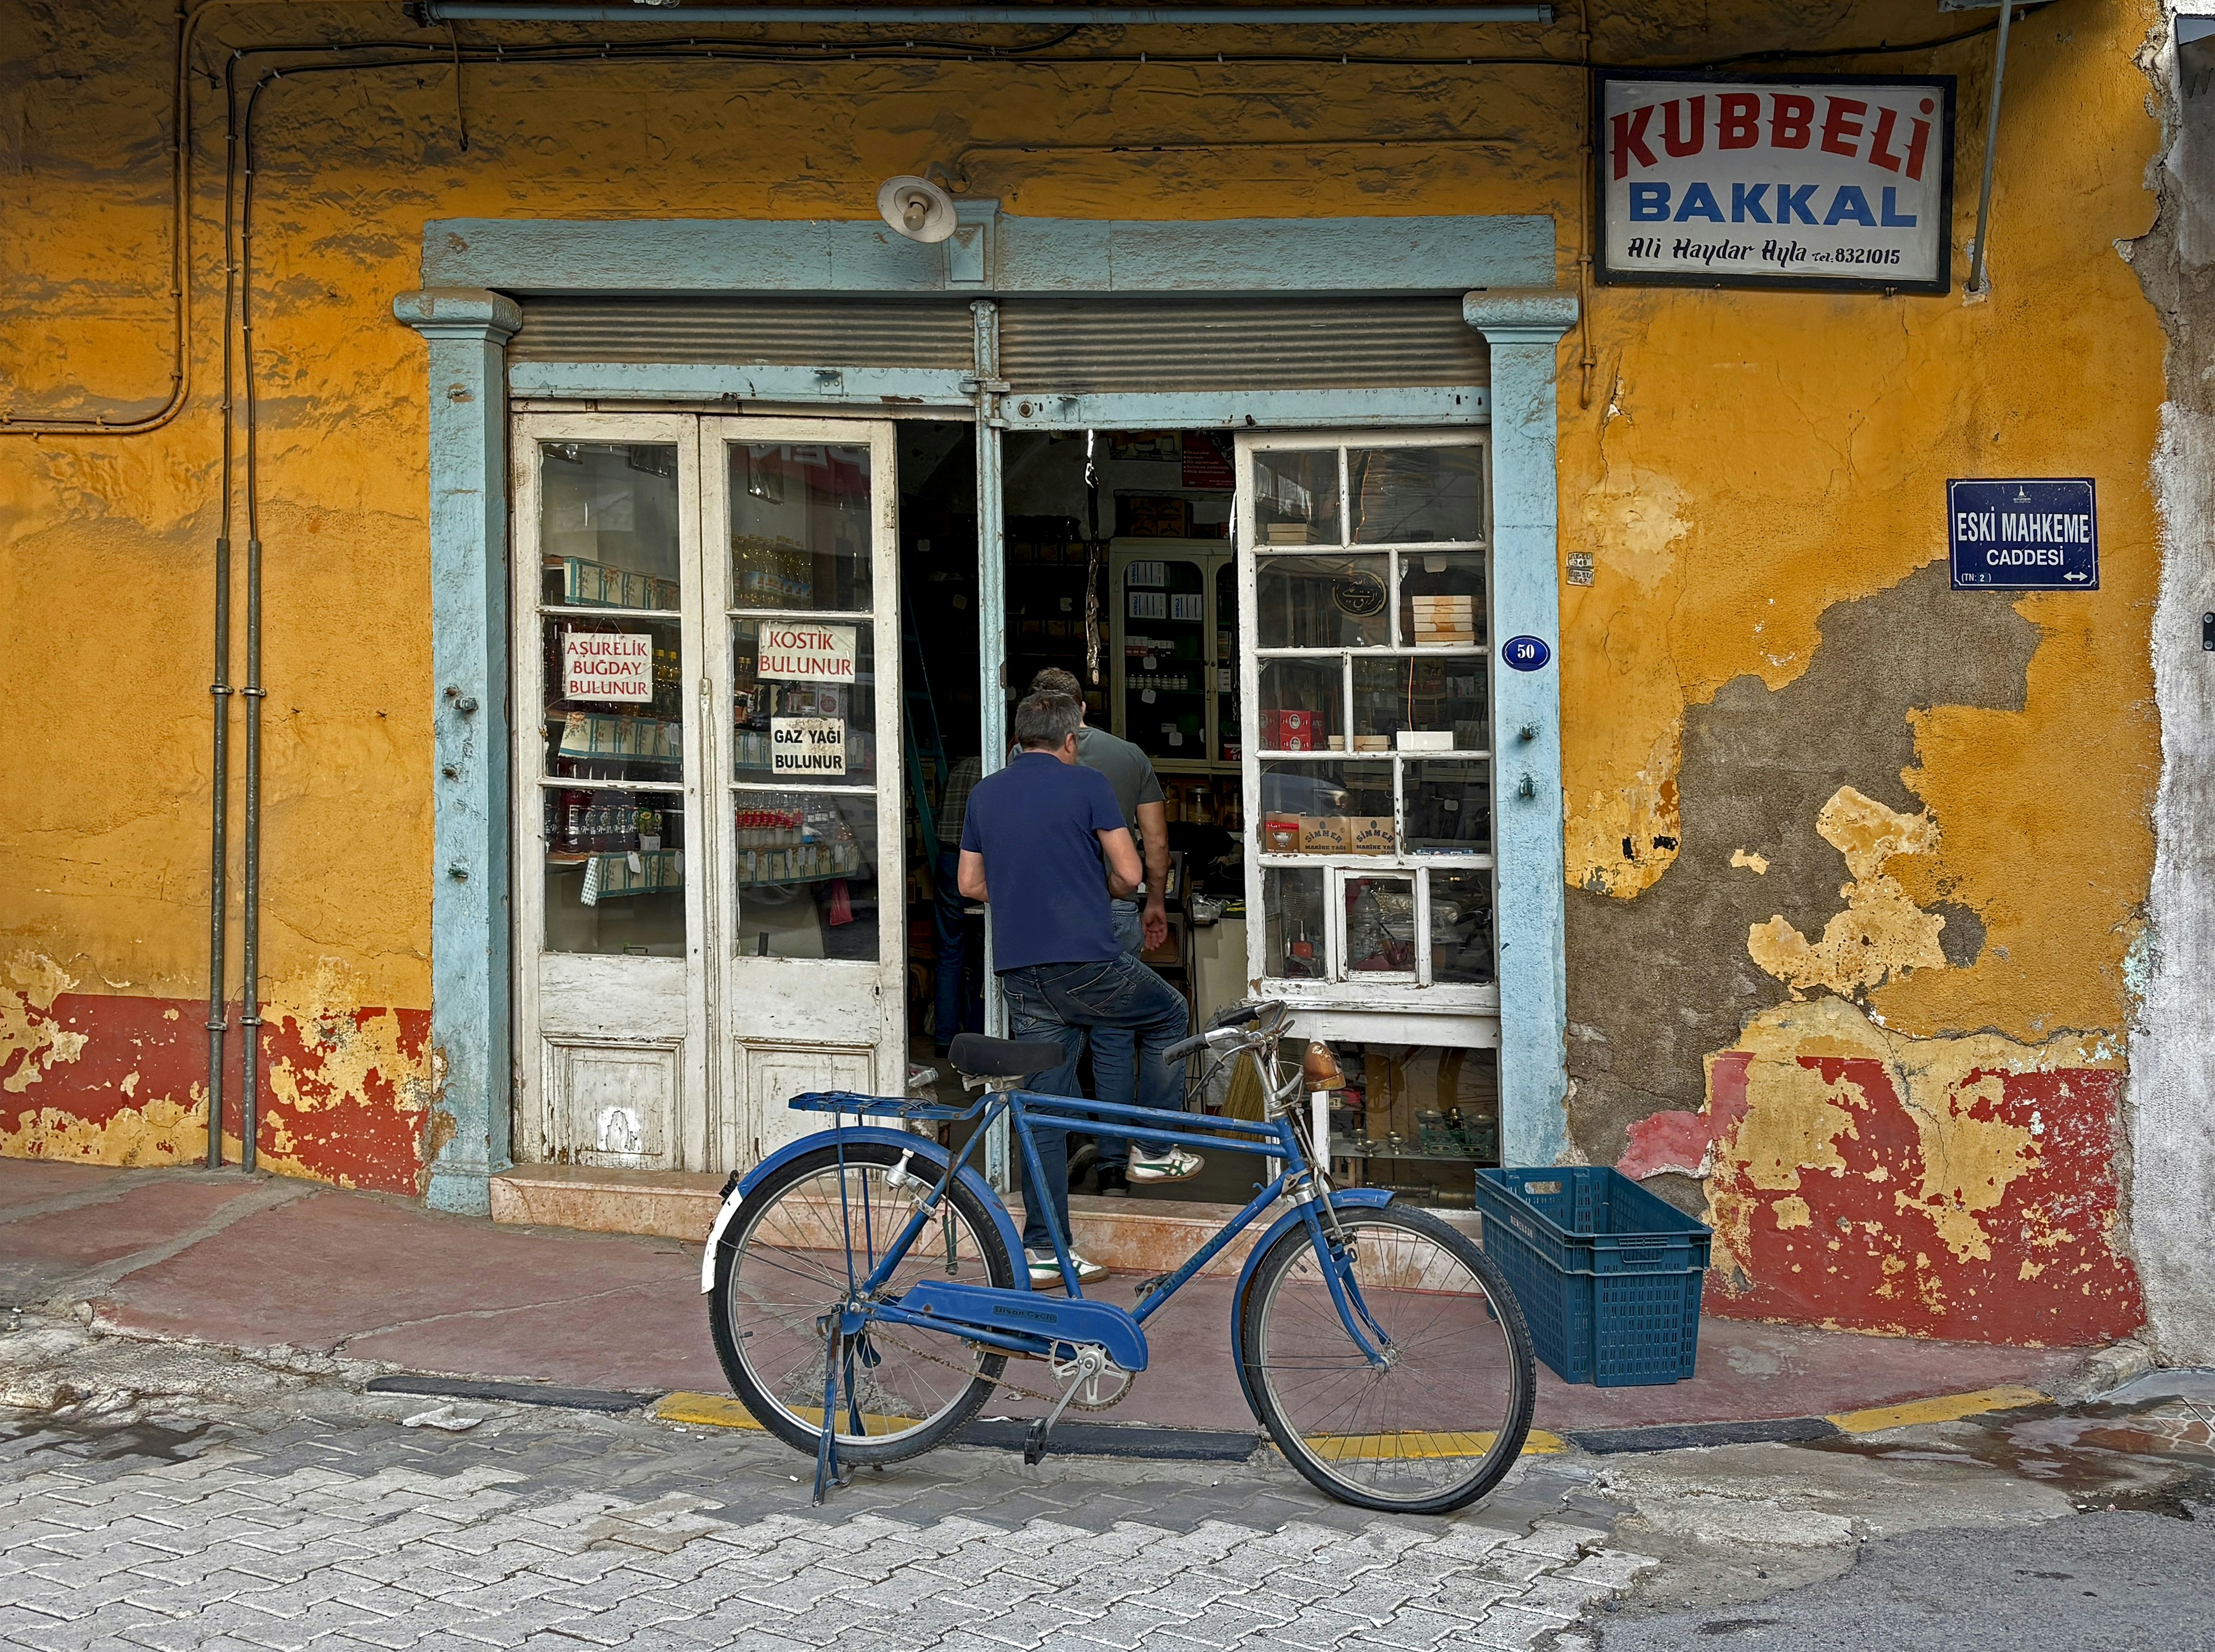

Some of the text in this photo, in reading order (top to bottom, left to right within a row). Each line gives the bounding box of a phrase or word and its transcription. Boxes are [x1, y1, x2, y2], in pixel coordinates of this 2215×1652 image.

[1609, 92, 1935, 182] KUBBELİ
[1629, 183, 1918, 228] BAKKAL
[1627, 237, 1661, 258] Ali
[1673, 238, 1756, 266] Haydar
[1761, 239, 1807, 268] Ayla
[1958, 506, 2089, 543] ESKİ MAHKEME
[1986, 545, 2064, 566] CADDESİ
[567, 639, 648, 658] AŞURELİK
[770, 630, 835, 651] KOSTİK
[1517, 644, 1535, 658] 50
[573, 659, 642, 676] BUĞDAY
[760, 655, 853, 676] BULUNUR
[570, 680, 648, 695] BULUNUR
[774, 725, 841, 744] GAZ YAĞI
[775, 755, 842, 769] BULUNUR
[1162, 1222, 1234, 1293] Bisan Cycle
[995, 1306, 1057, 1321] Bisan Cycle
